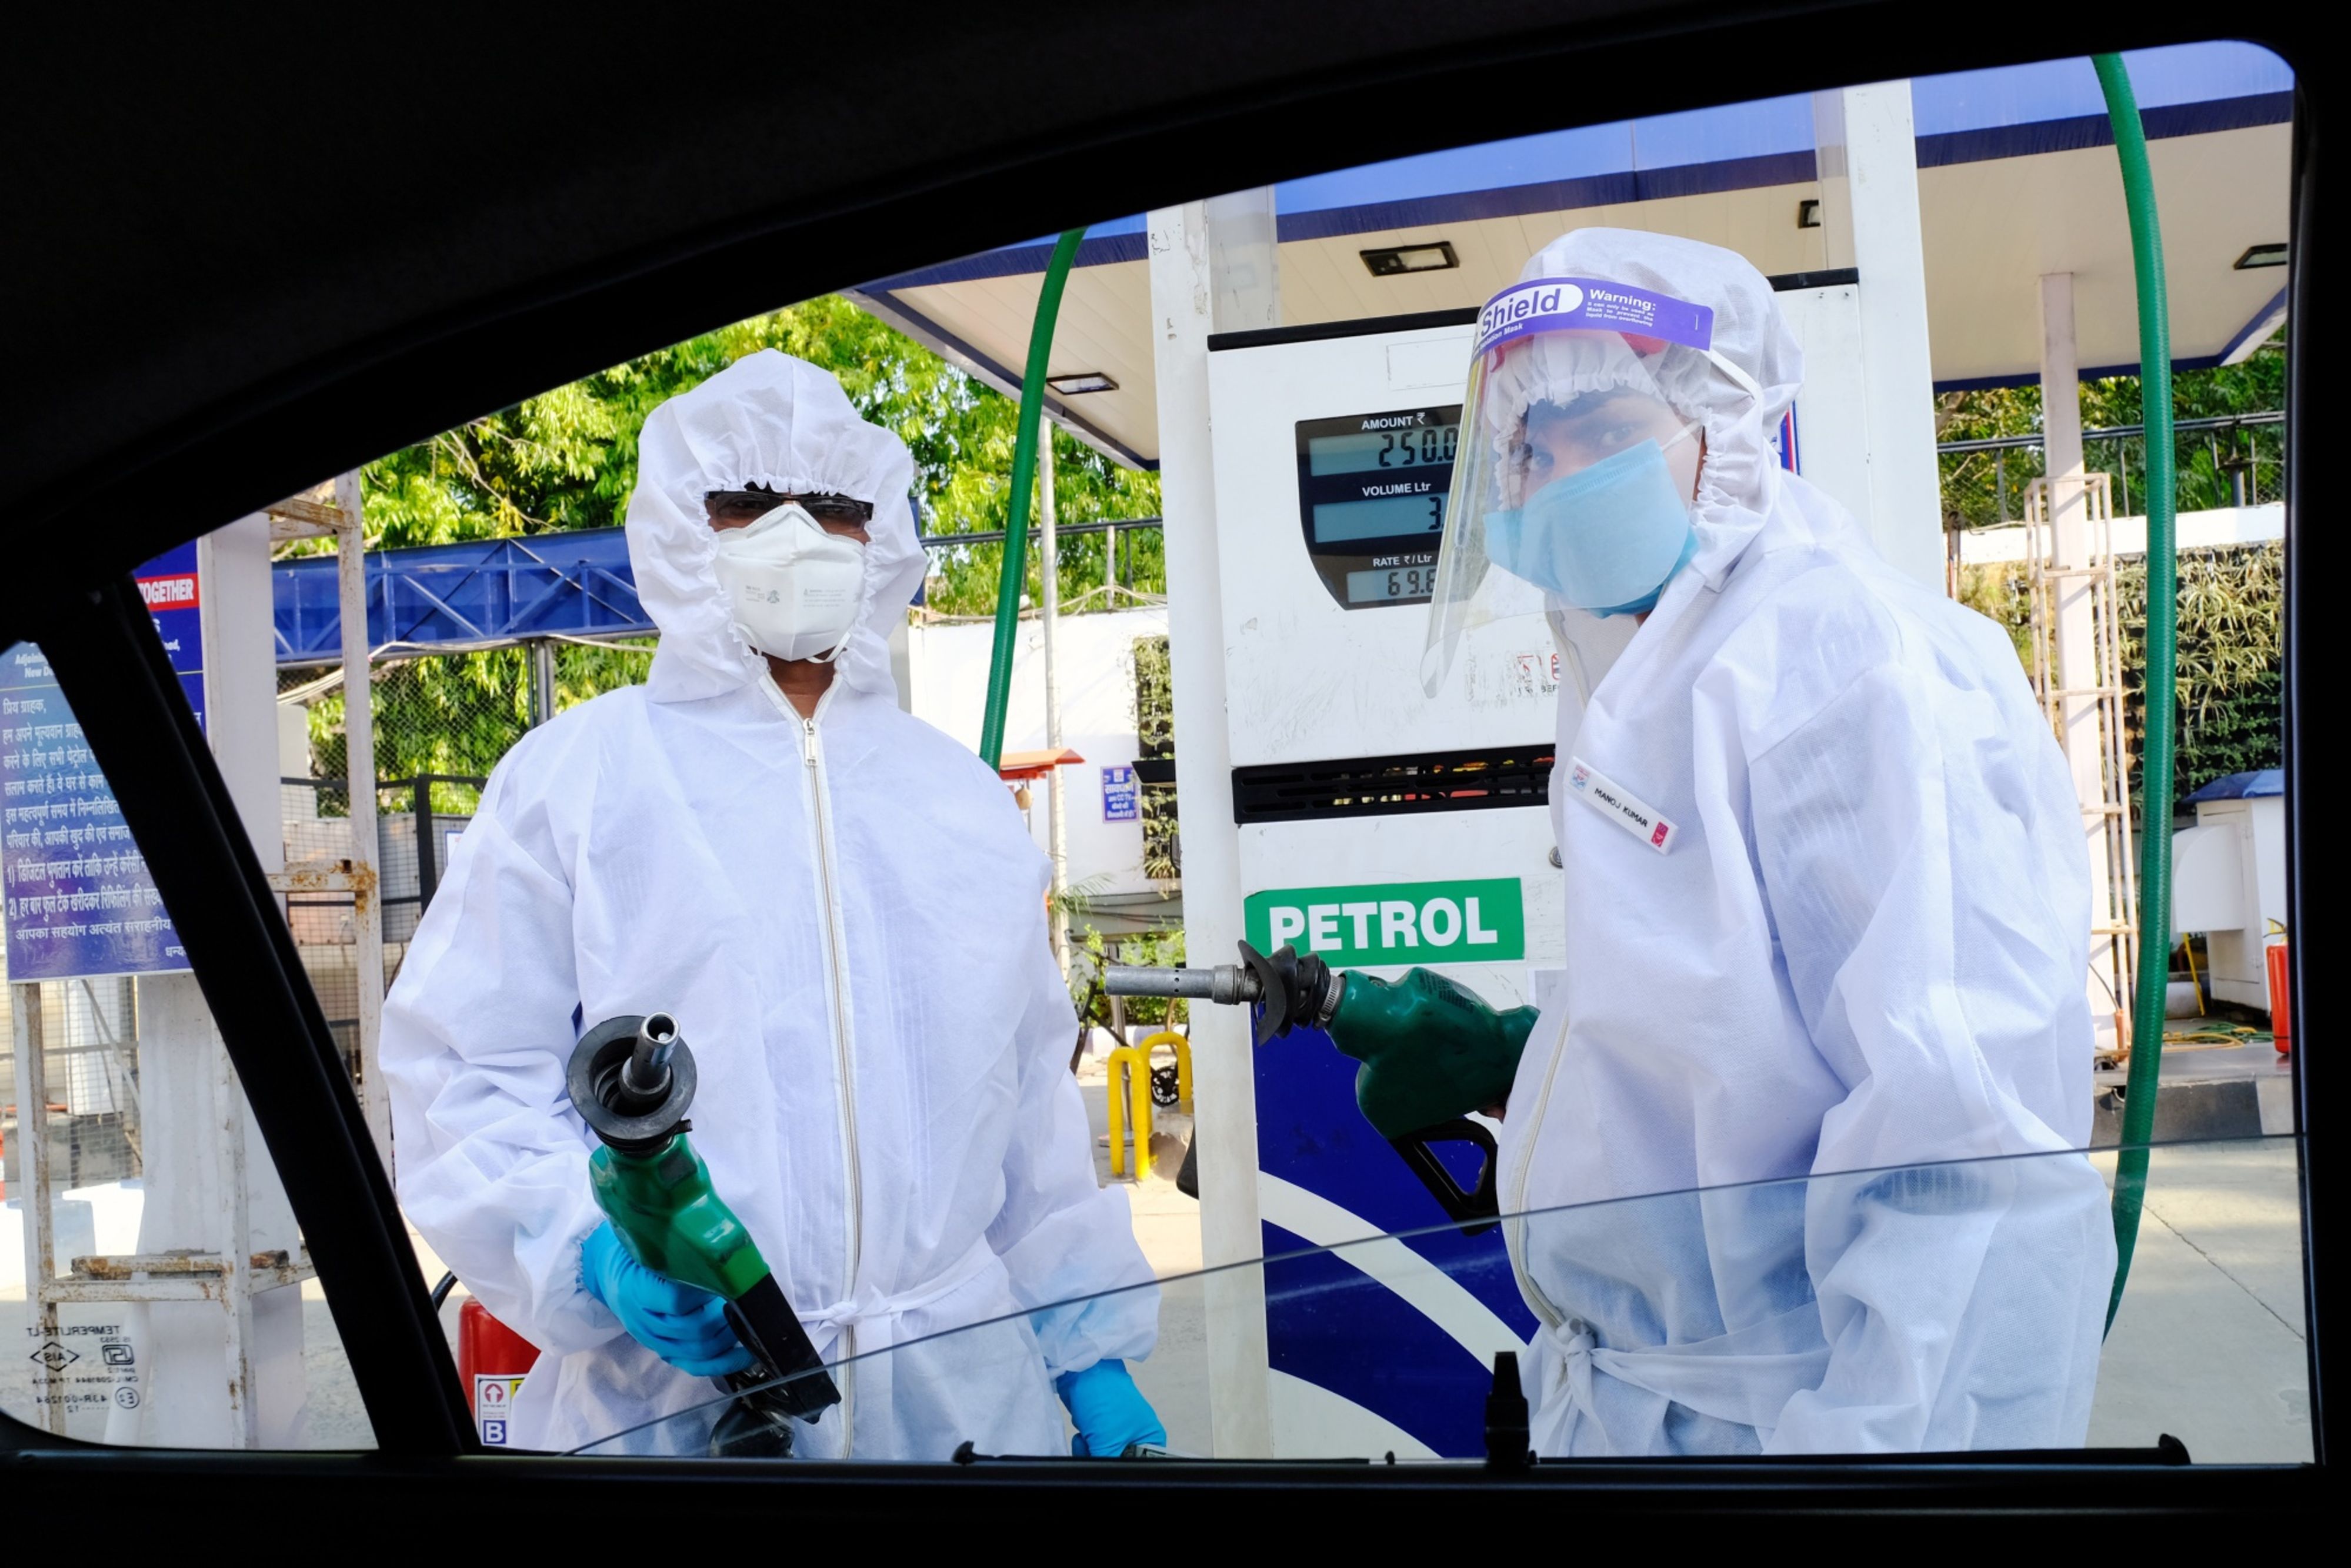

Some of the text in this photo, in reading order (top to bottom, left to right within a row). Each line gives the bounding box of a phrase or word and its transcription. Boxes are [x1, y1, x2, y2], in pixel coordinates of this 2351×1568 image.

[1590, 289, 1656, 311] Warning:
[1481, 288, 1560, 336] Shield
[1362, 415, 1413, 430] AMOUNT
[1362, 482, 1431, 497] VOLUME Ltr
[1373, 556, 1400, 568] RATE
[1595, 788, 1648, 827] MANOJ KUMAR
[1269, 897, 1498, 953] PETROL
[485, 1422, 504, 1443] B
